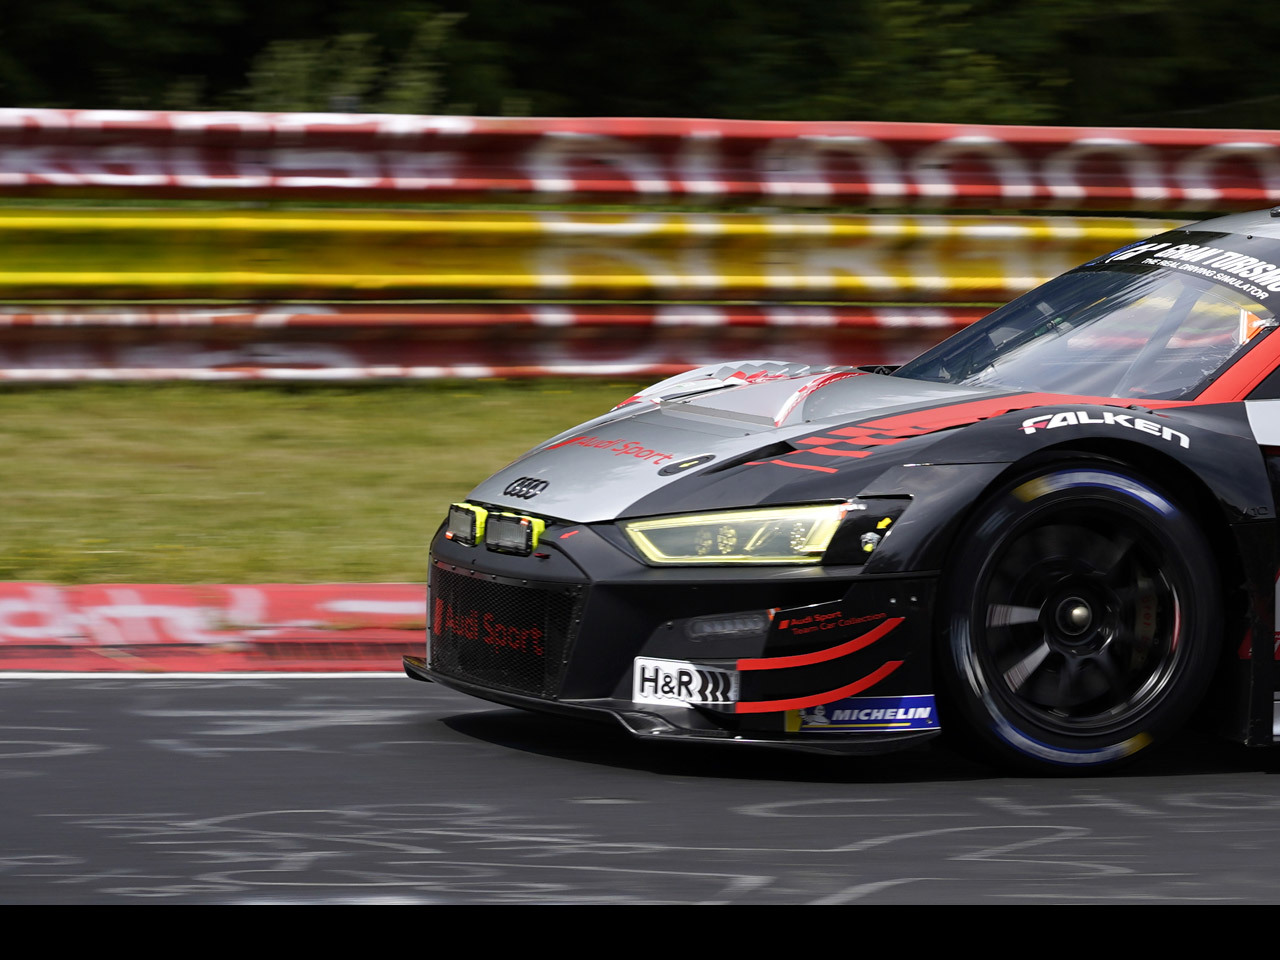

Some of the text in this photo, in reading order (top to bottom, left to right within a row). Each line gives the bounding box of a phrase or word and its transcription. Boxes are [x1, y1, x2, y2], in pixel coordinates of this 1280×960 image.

[1153, 243, 1224, 262] GRAN
[1157, 260, 1181, 269] REAL
[1178, 263, 1216, 277] DRIVING
[1213, 273, 1269, 300] SIMULATOR
[1018, 411, 1190, 449] FALKEN
[611, 441, 674, 465] Sport
[790, 611, 842, 625] Audi Sport
[482, 612, 544, 656] Sport
[640, 664, 693, 697] H&R
[831, 707, 932, 721] MICHELIN
